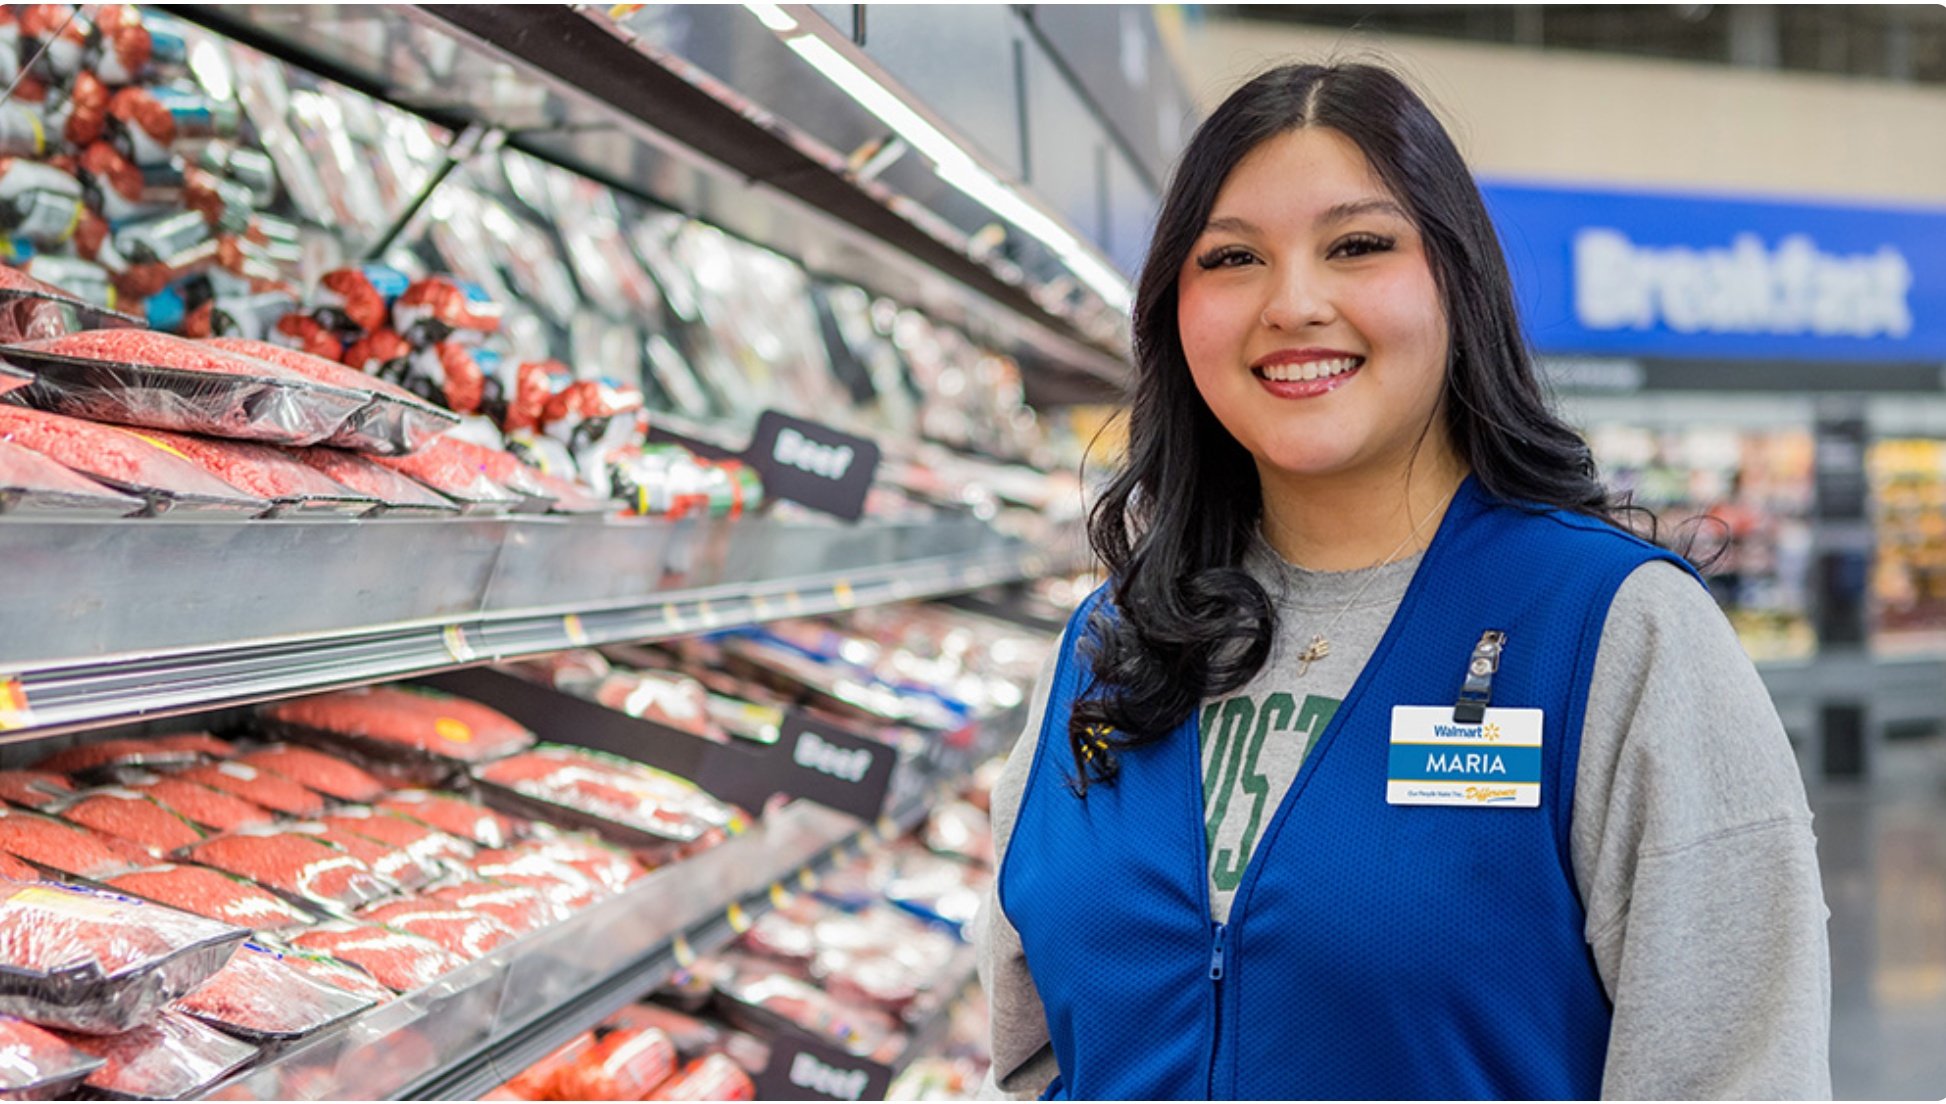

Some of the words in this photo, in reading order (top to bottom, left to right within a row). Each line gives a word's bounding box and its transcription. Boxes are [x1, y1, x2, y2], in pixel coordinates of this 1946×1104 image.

[1573, 230, 1913, 337] Breakfast
[774, 427, 854, 480] Beef
[1434, 724, 1482, 738] Walmart
[793, 731, 872, 782] Beef
[1426, 753, 1506, 774] MARIA
[790, 1052, 869, 1101] Beef
